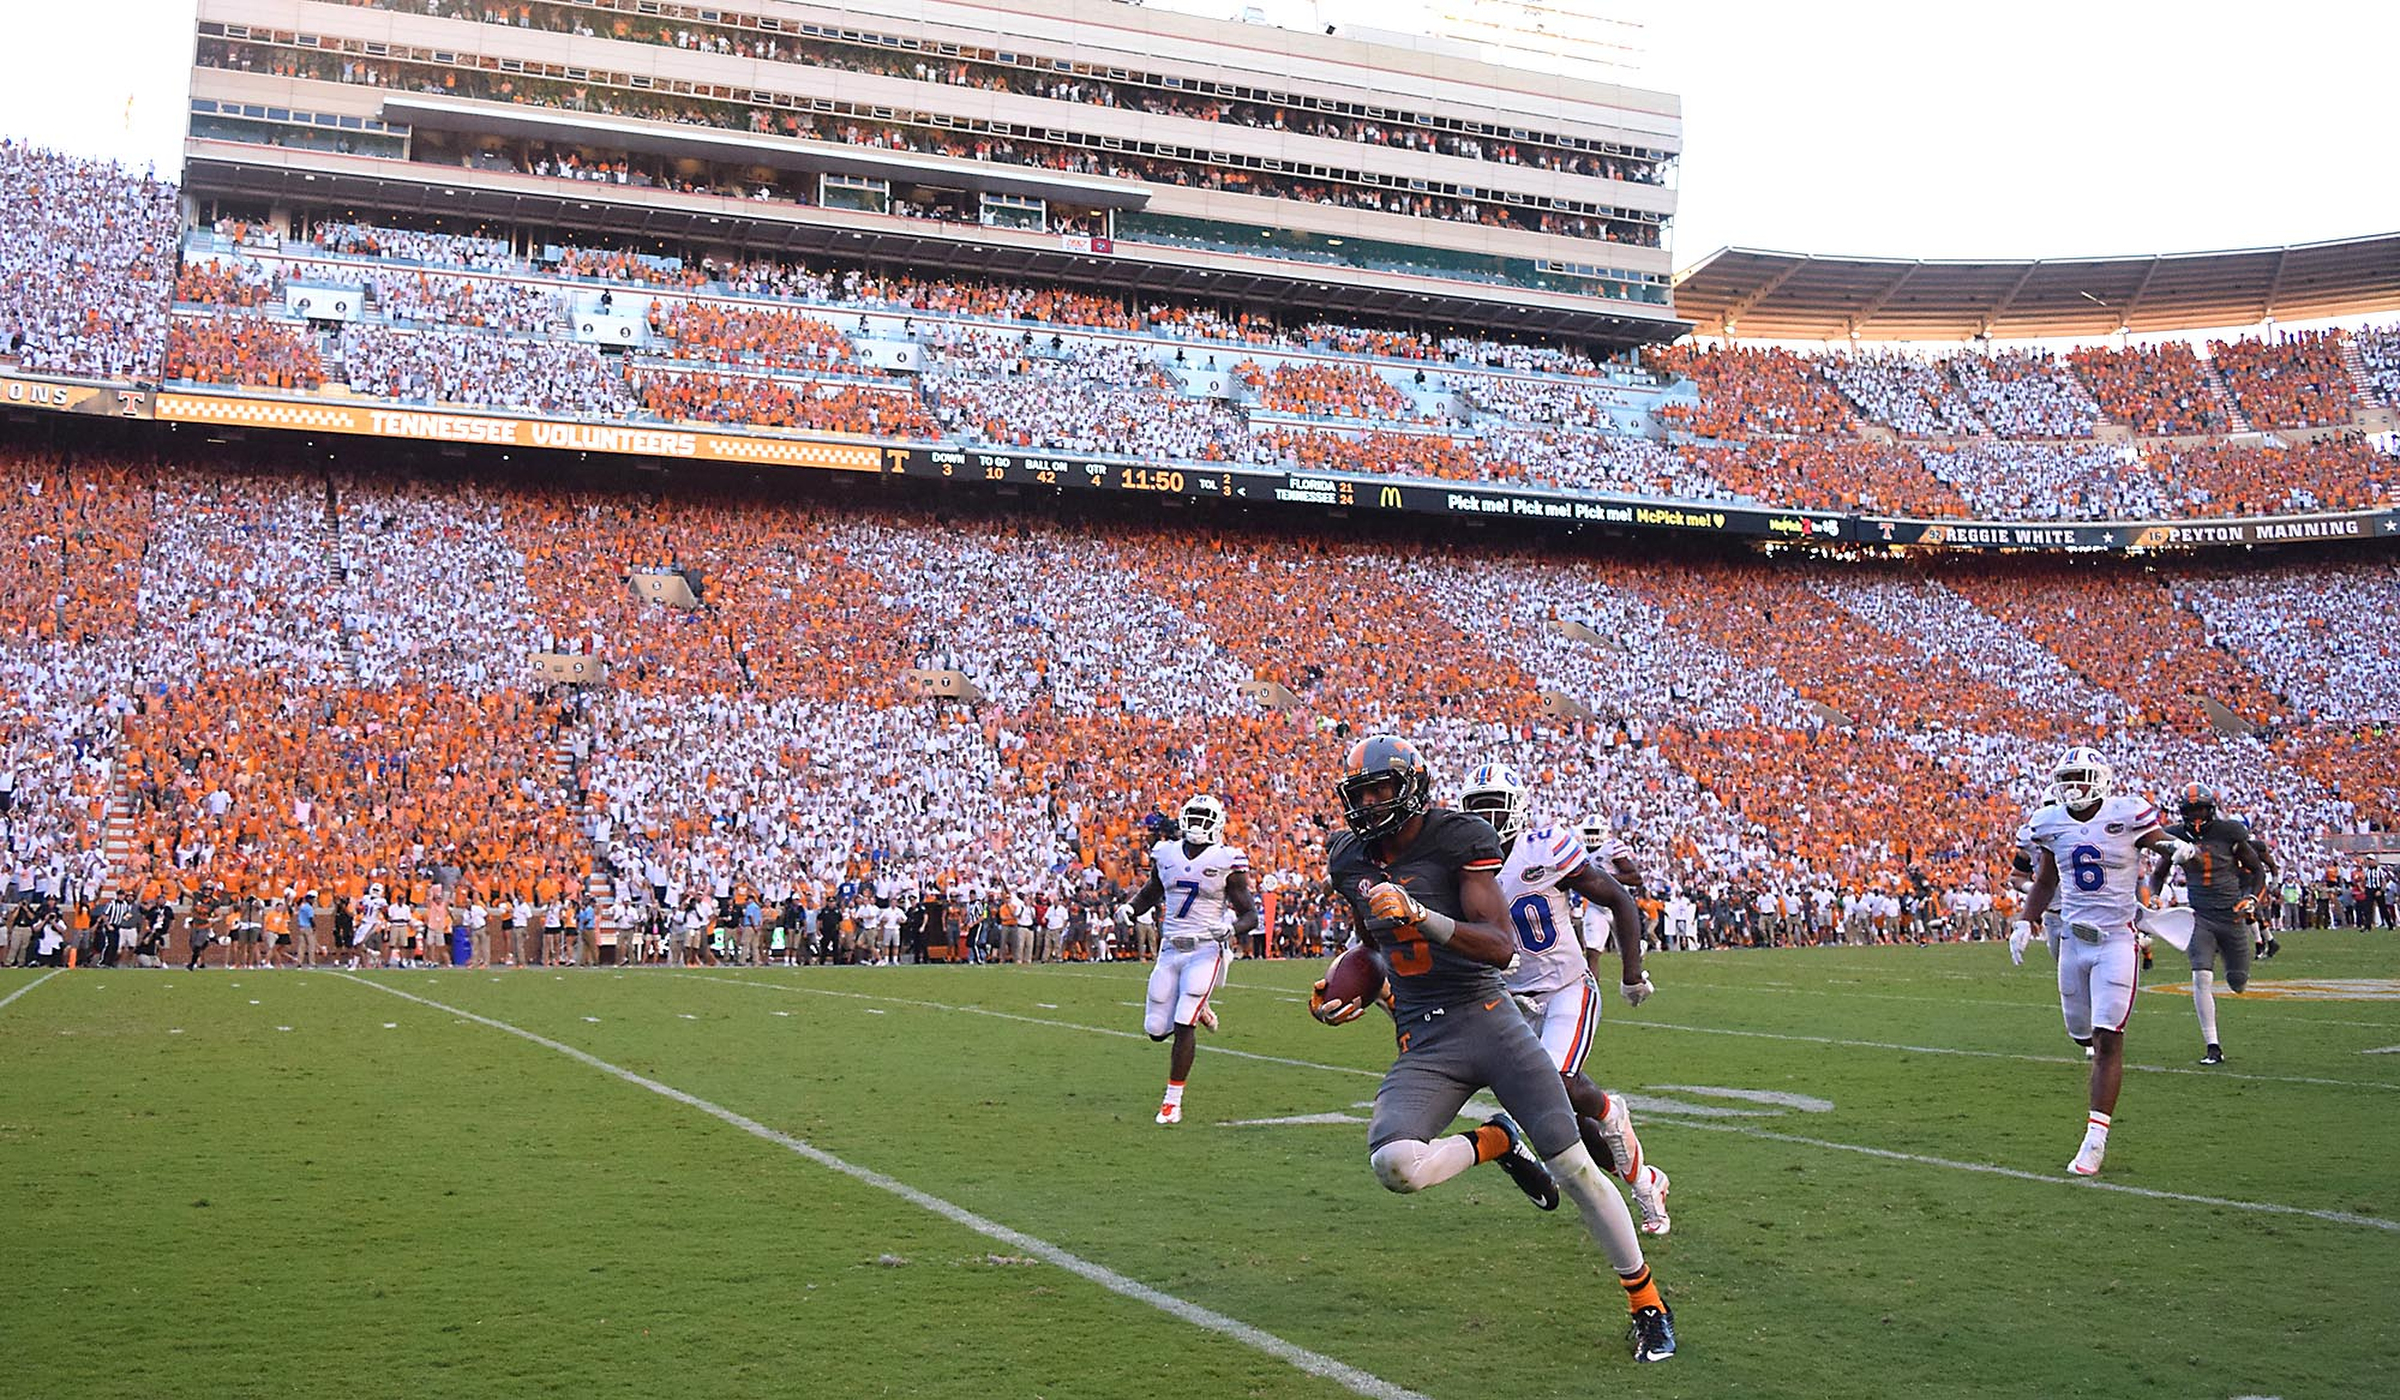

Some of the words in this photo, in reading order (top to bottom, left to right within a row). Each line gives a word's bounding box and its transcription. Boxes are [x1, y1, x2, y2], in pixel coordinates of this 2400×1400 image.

[0, 382, 68, 405] ONS
[370, 410, 518, 442] TENNESSEE
[532, 423, 697, 456] VOLUNTEERS
[932, 452, 965, 465] DOWN
[979, 455, 994, 468] TO
[995, 456, 1011, 469] GO
[1025, 458, 1051, 472] BALL
[1052, 461, 1068, 473] ON
[942, 464, 953, 476] 3
[985, 467, 1004, 481] 10
[1037, 470, 1056, 484] 42
[1085, 463, 1107, 476] QTR
[1091, 474, 1101, 487] 4
[1121, 469, 1184, 493] 11:50
[1199, 479, 1218, 491] TOL
[1223, 474, 1231, 485] 2
[1289, 478, 1336, 493] FLORIDA
[1339, 482, 1354, 493] 21
[1223, 485, 1232, 497] 3
[1274, 488, 1336, 505] TENNESSEE
[1339, 493, 1355, 506] 24
[1447, 494, 1480, 512] Pick
[1482, 497, 1509, 514] me!
[1512, 498, 1546, 516] Pick
[1548, 501, 1571, 518] me!
[1575, 503, 1604, 521] Pick
[1605, 507, 1632, 522] me!
[1636, 509, 1685, 527] McPick
[1686, 512, 1712, 528] me!
[1801, 516, 1813, 535] 2
[2149, 530, 2162, 543] 16
[2168, 526, 2244, 543] PEYTON
[2255, 521, 2359, 540] MANNING
[1928, 529, 1942, 541] 92
[1945, 527, 2010, 544] REGGIE
[2014, 528, 2076, 544] WHITE
[2072, 843, 2107, 893] 6
[2202, 851, 2213, 886] 1
[1175, 880, 1200, 919] 7
[1509, 890, 1560, 956] 0
